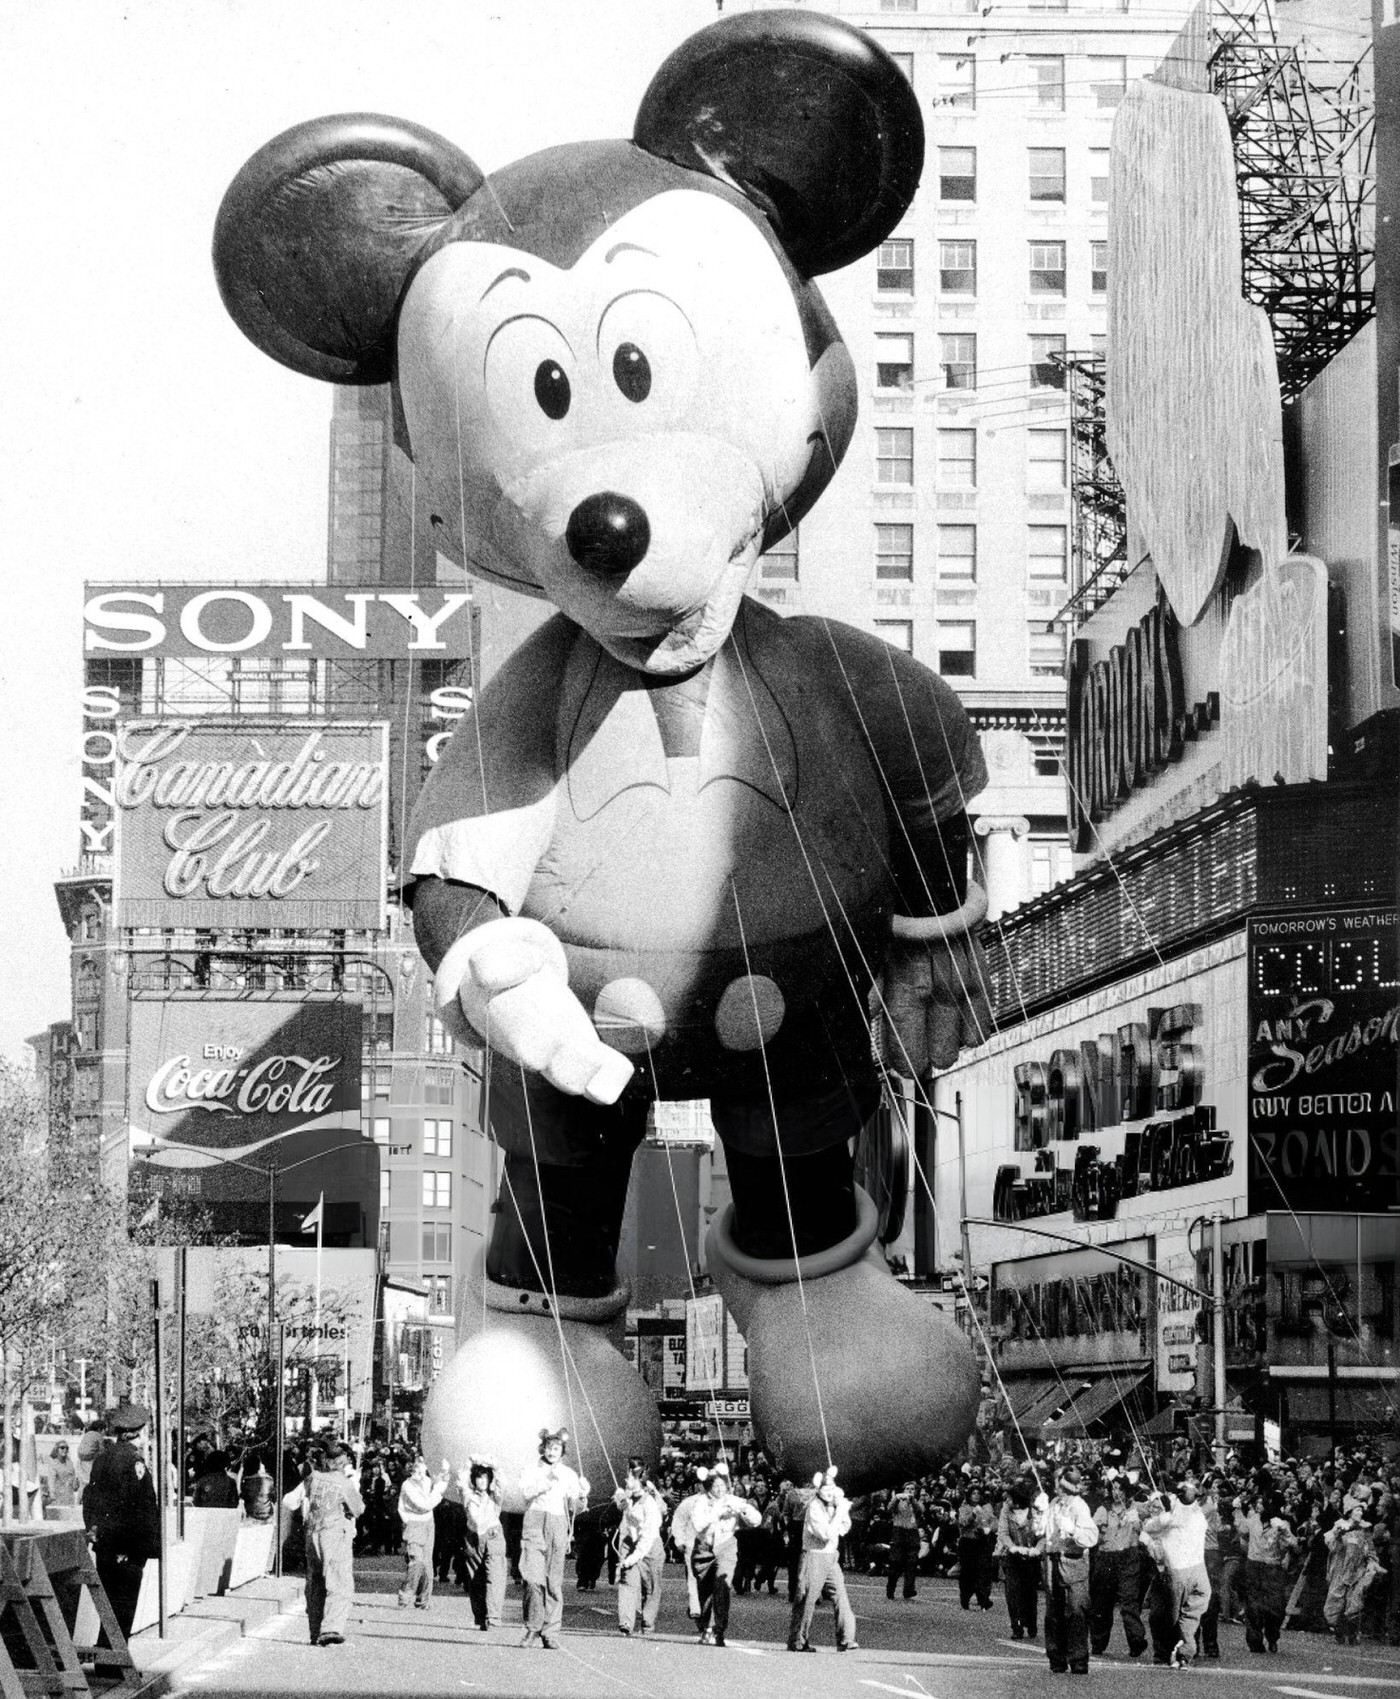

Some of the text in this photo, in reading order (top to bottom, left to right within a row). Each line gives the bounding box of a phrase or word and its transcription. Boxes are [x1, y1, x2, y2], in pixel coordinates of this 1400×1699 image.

[83, 590, 472, 652] SONY
[116, 721, 381, 809] Canadian
[163, 810, 332, 899] Club
[1253, 917, 1337, 935] TOMORROW'S
[203, 1043, 243, 1062] Enjoy
[1257, 1018, 1312, 1042] ANY
[145, 1054, 342, 1114] Coca-Cola
